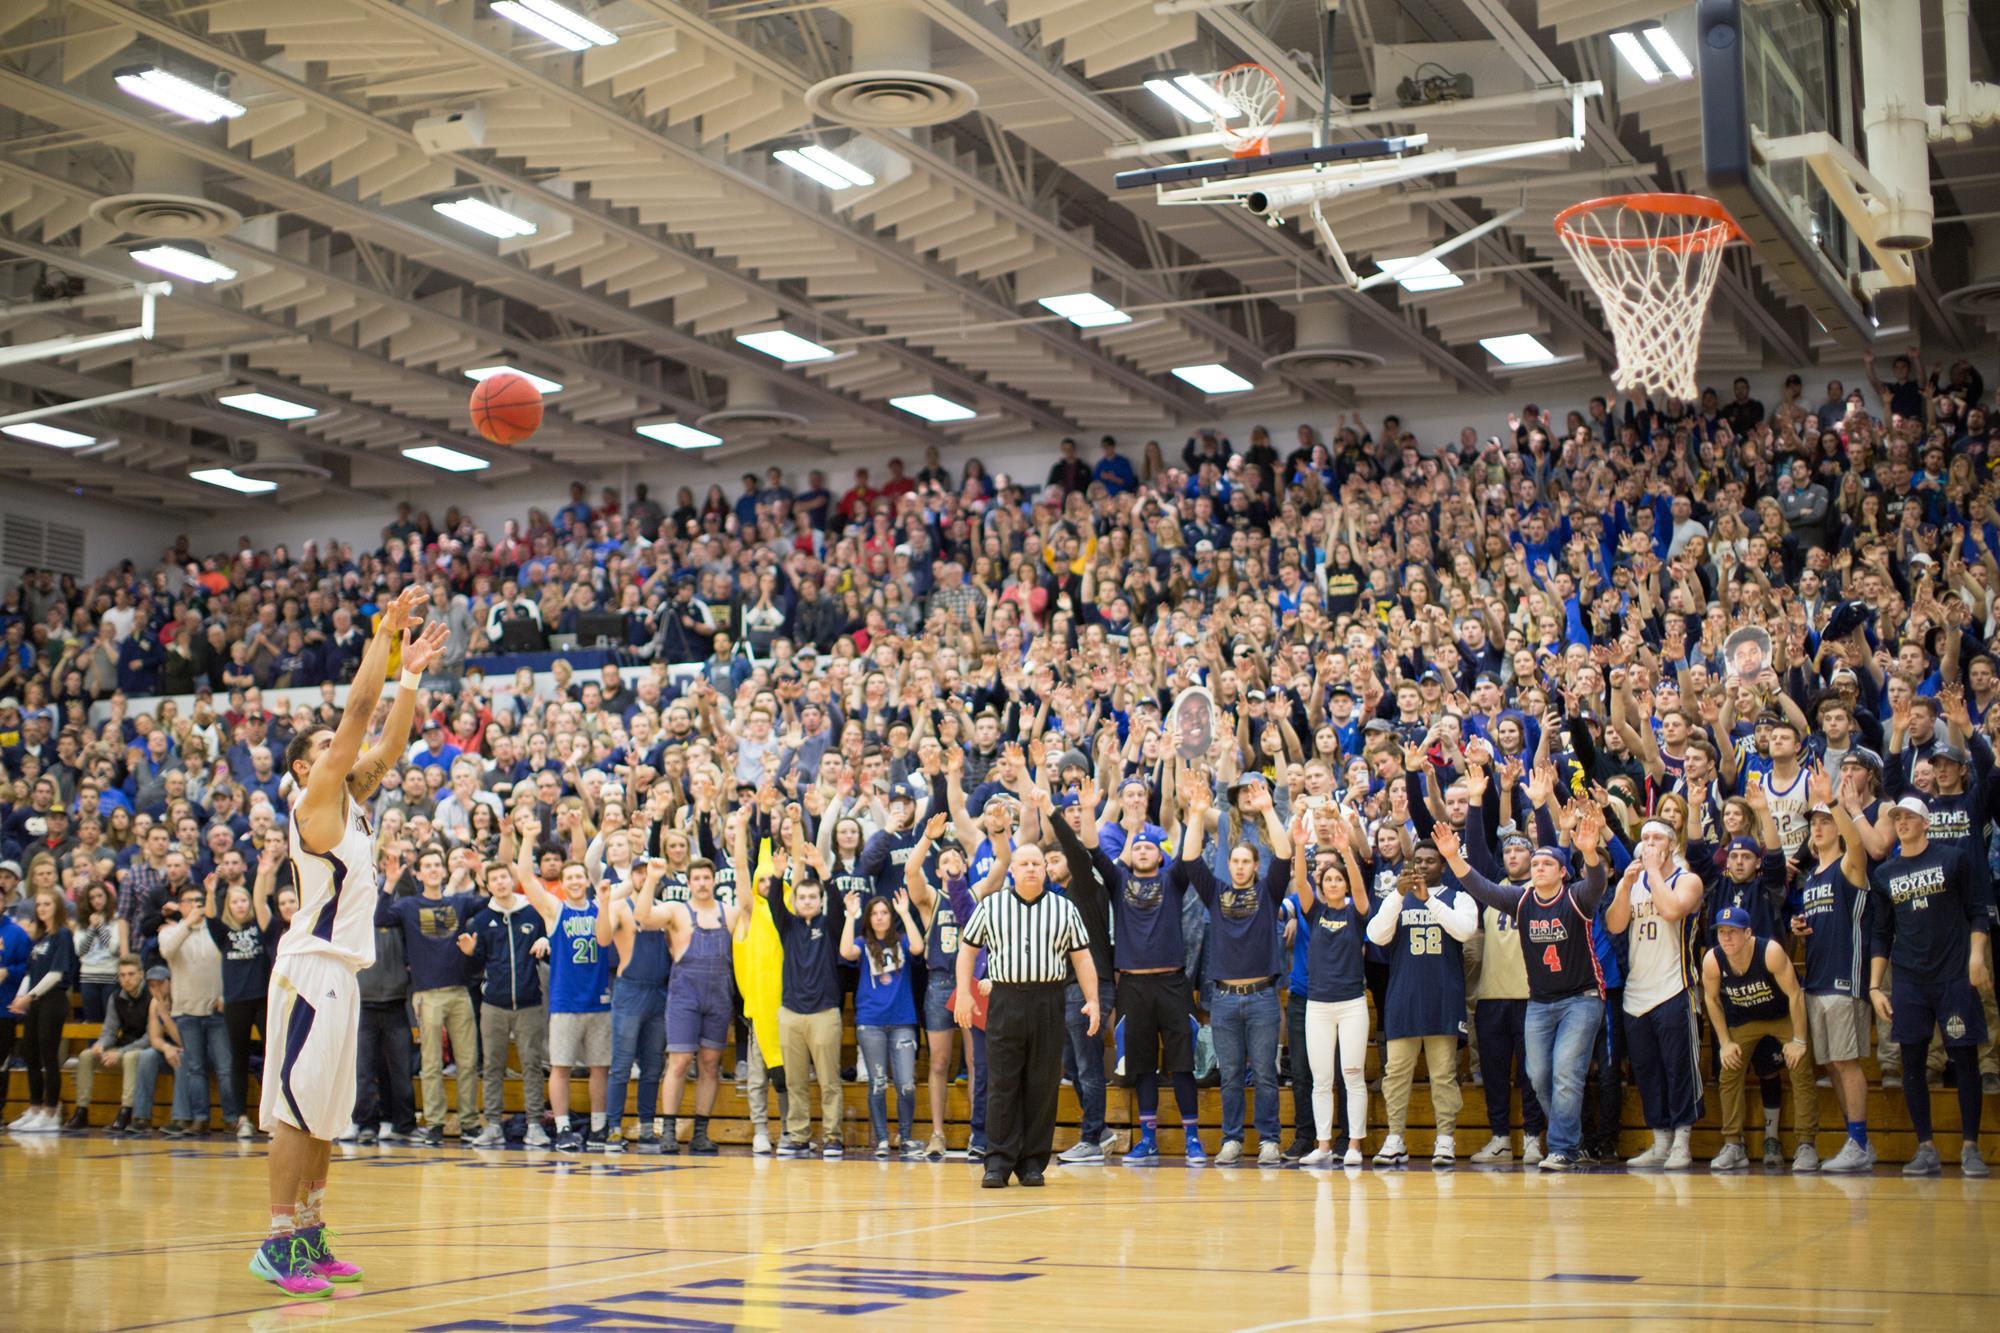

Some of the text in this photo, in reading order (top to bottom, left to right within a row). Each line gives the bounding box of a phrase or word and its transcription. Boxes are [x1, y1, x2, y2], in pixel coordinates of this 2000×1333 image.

[1890, 871, 1945, 897] ROYALS
[1892, 883, 1946, 905] SOFTBALL
[1723, 908, 1732, 920] B
[1410, 927, 1442, 956] 52
[1529, 918, 1568, 941] USA
[572, 937, 598, 965] 21
[1542, 944, 1562, 973] 4
[1725, 981, 1770, 998] BETHEL
